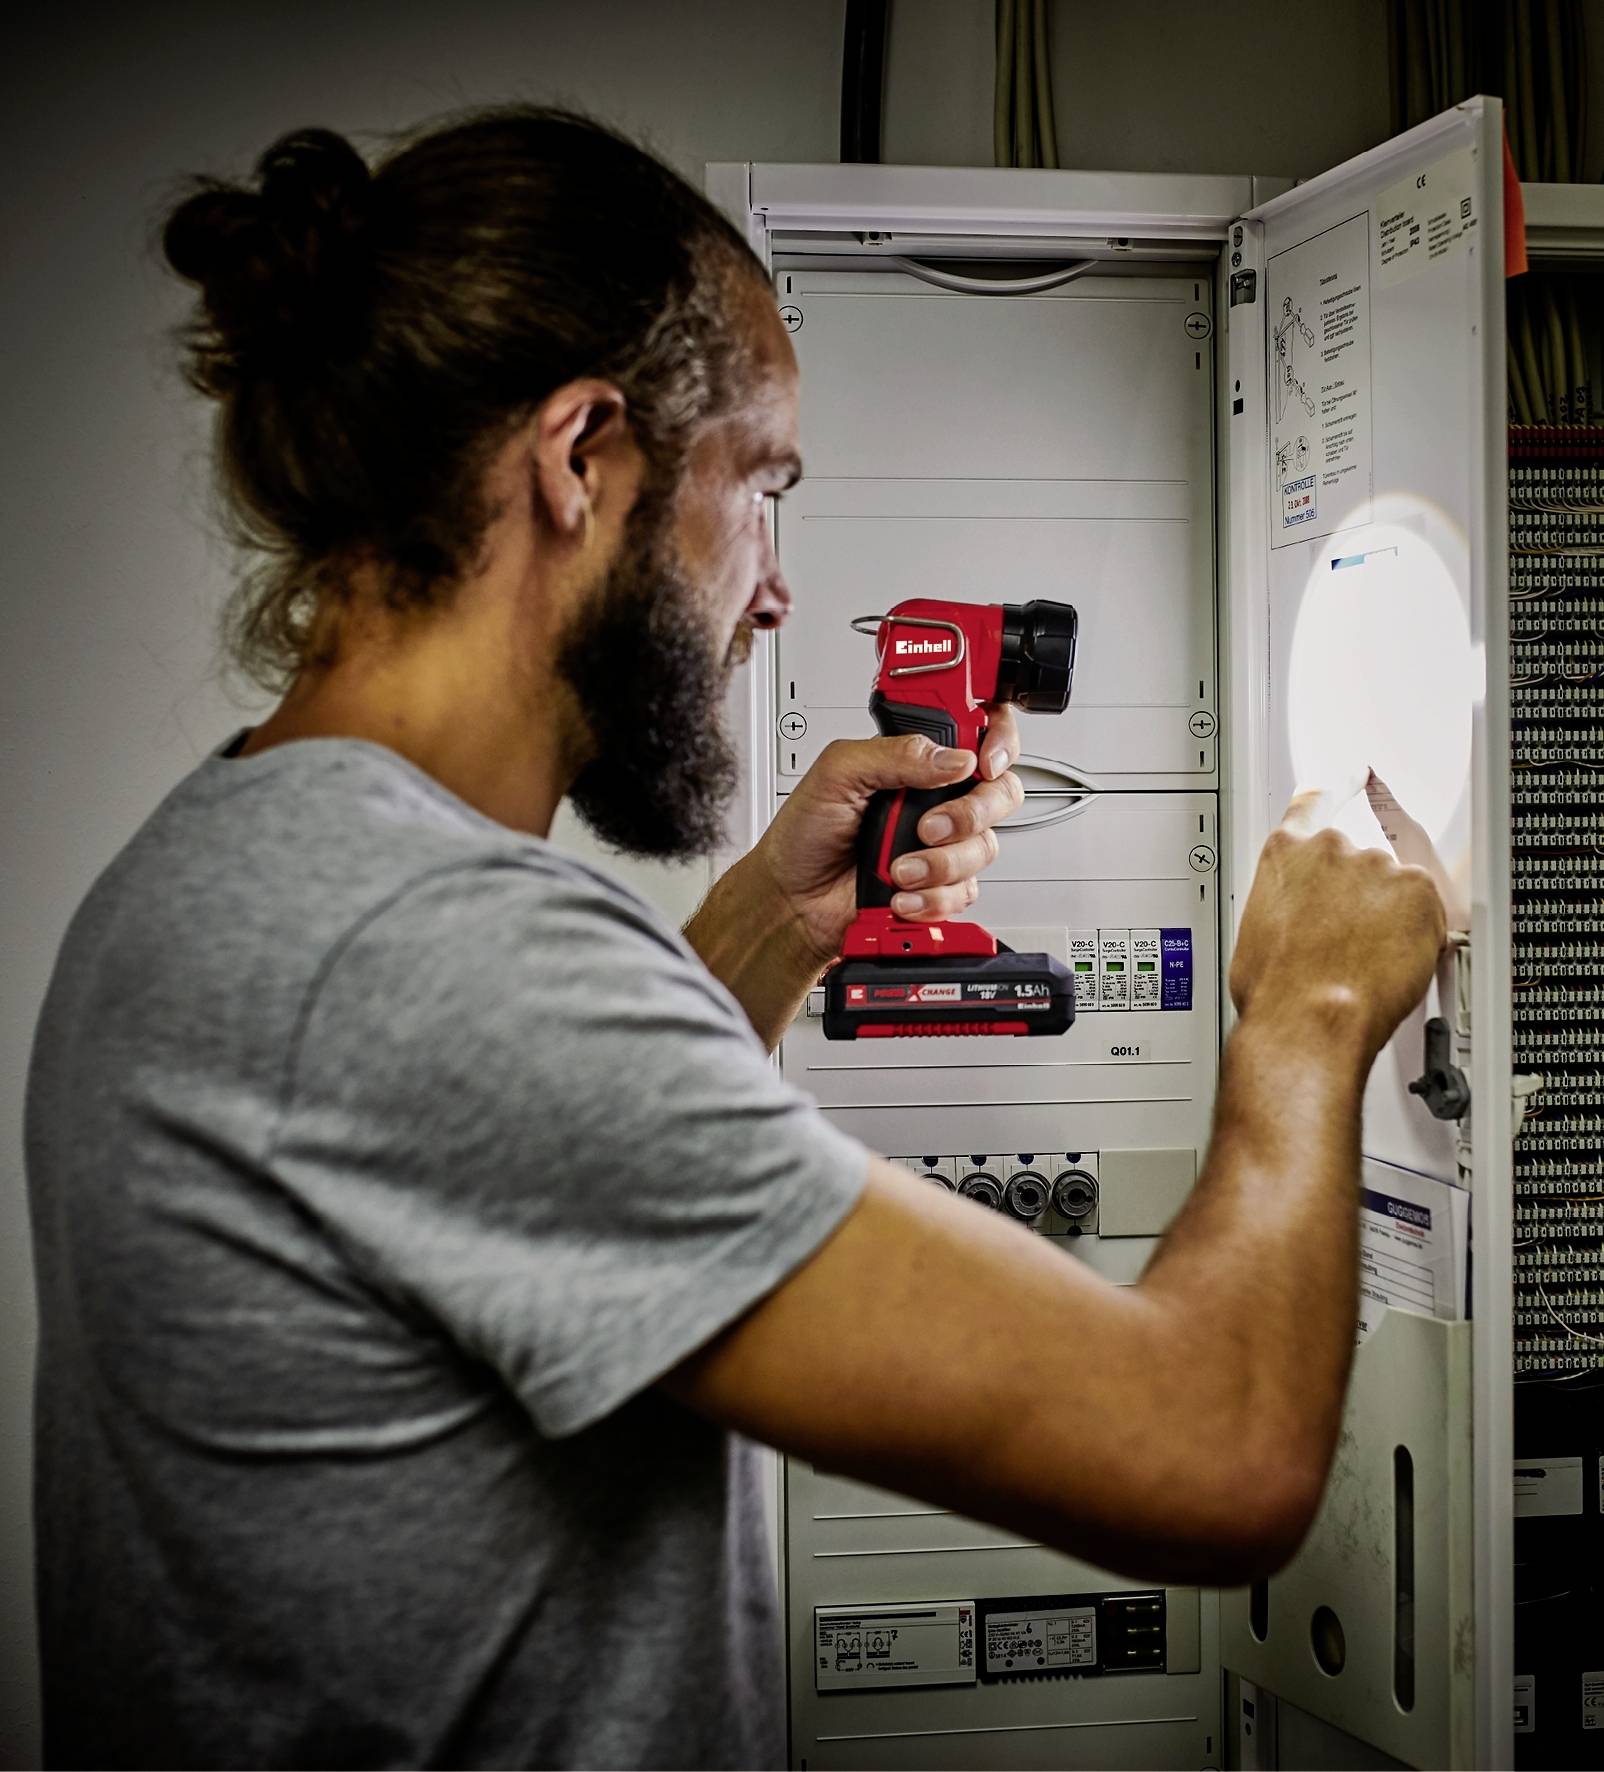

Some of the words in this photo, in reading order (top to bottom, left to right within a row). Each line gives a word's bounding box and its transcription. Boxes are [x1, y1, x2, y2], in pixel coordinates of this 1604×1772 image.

[1284, 478, 1315, 496] KONTROLLE
[1284, 512, 1305, 525] Nummer
[1305, 508, 1315, 519] 506
[896, 640, 952, 654] Einhell
[921, 988, 956, 997] CHANGE
[979, 991, 997, 1000] 18V
[1013, 984, 1050, 998] 1.5Ah
[1111, 1047, 1140, 1056] Q01.1
[1026, 1623, 1032, 1634] 6
